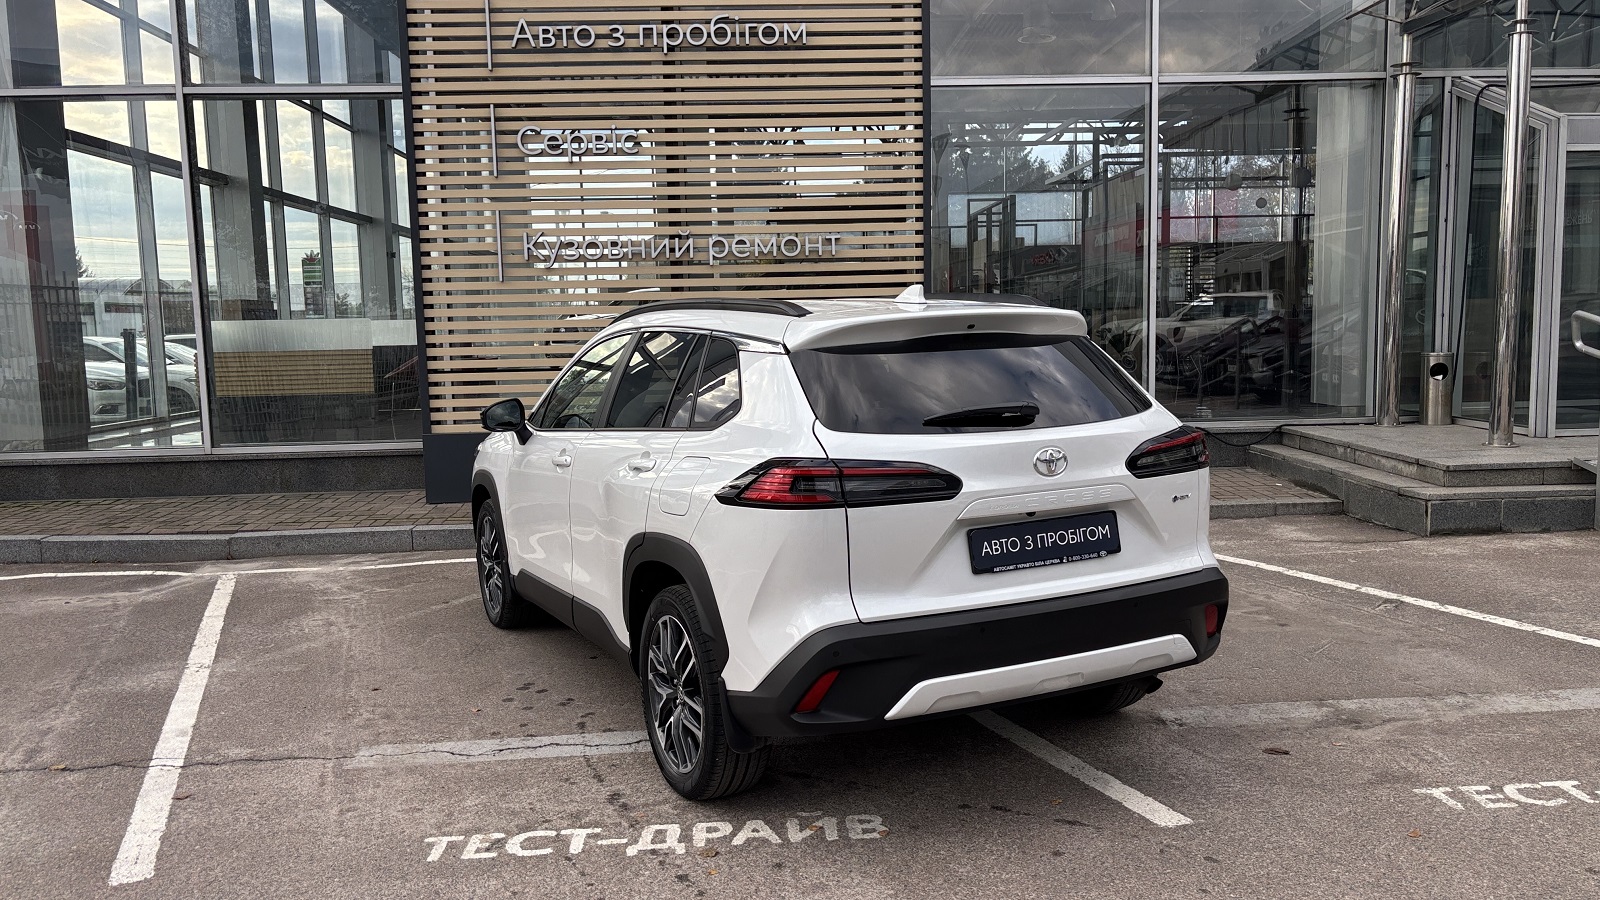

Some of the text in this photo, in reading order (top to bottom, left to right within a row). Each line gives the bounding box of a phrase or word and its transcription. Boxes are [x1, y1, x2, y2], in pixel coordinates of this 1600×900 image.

[511, 14, 809, 55] Авто з пробігом
[516, 124, 640, 164] Сервіс
[521, 229, 842, 270] Кузовний ремонт
[981, 536, 1021, 557] АВТО
[1036, 524, 1111, 549] ПРОБІГОМ
[1412, 780, 1600, 810] ТЕСТ
[423, 810, 890, 862] ТЕСТ-ДРАЙВ
